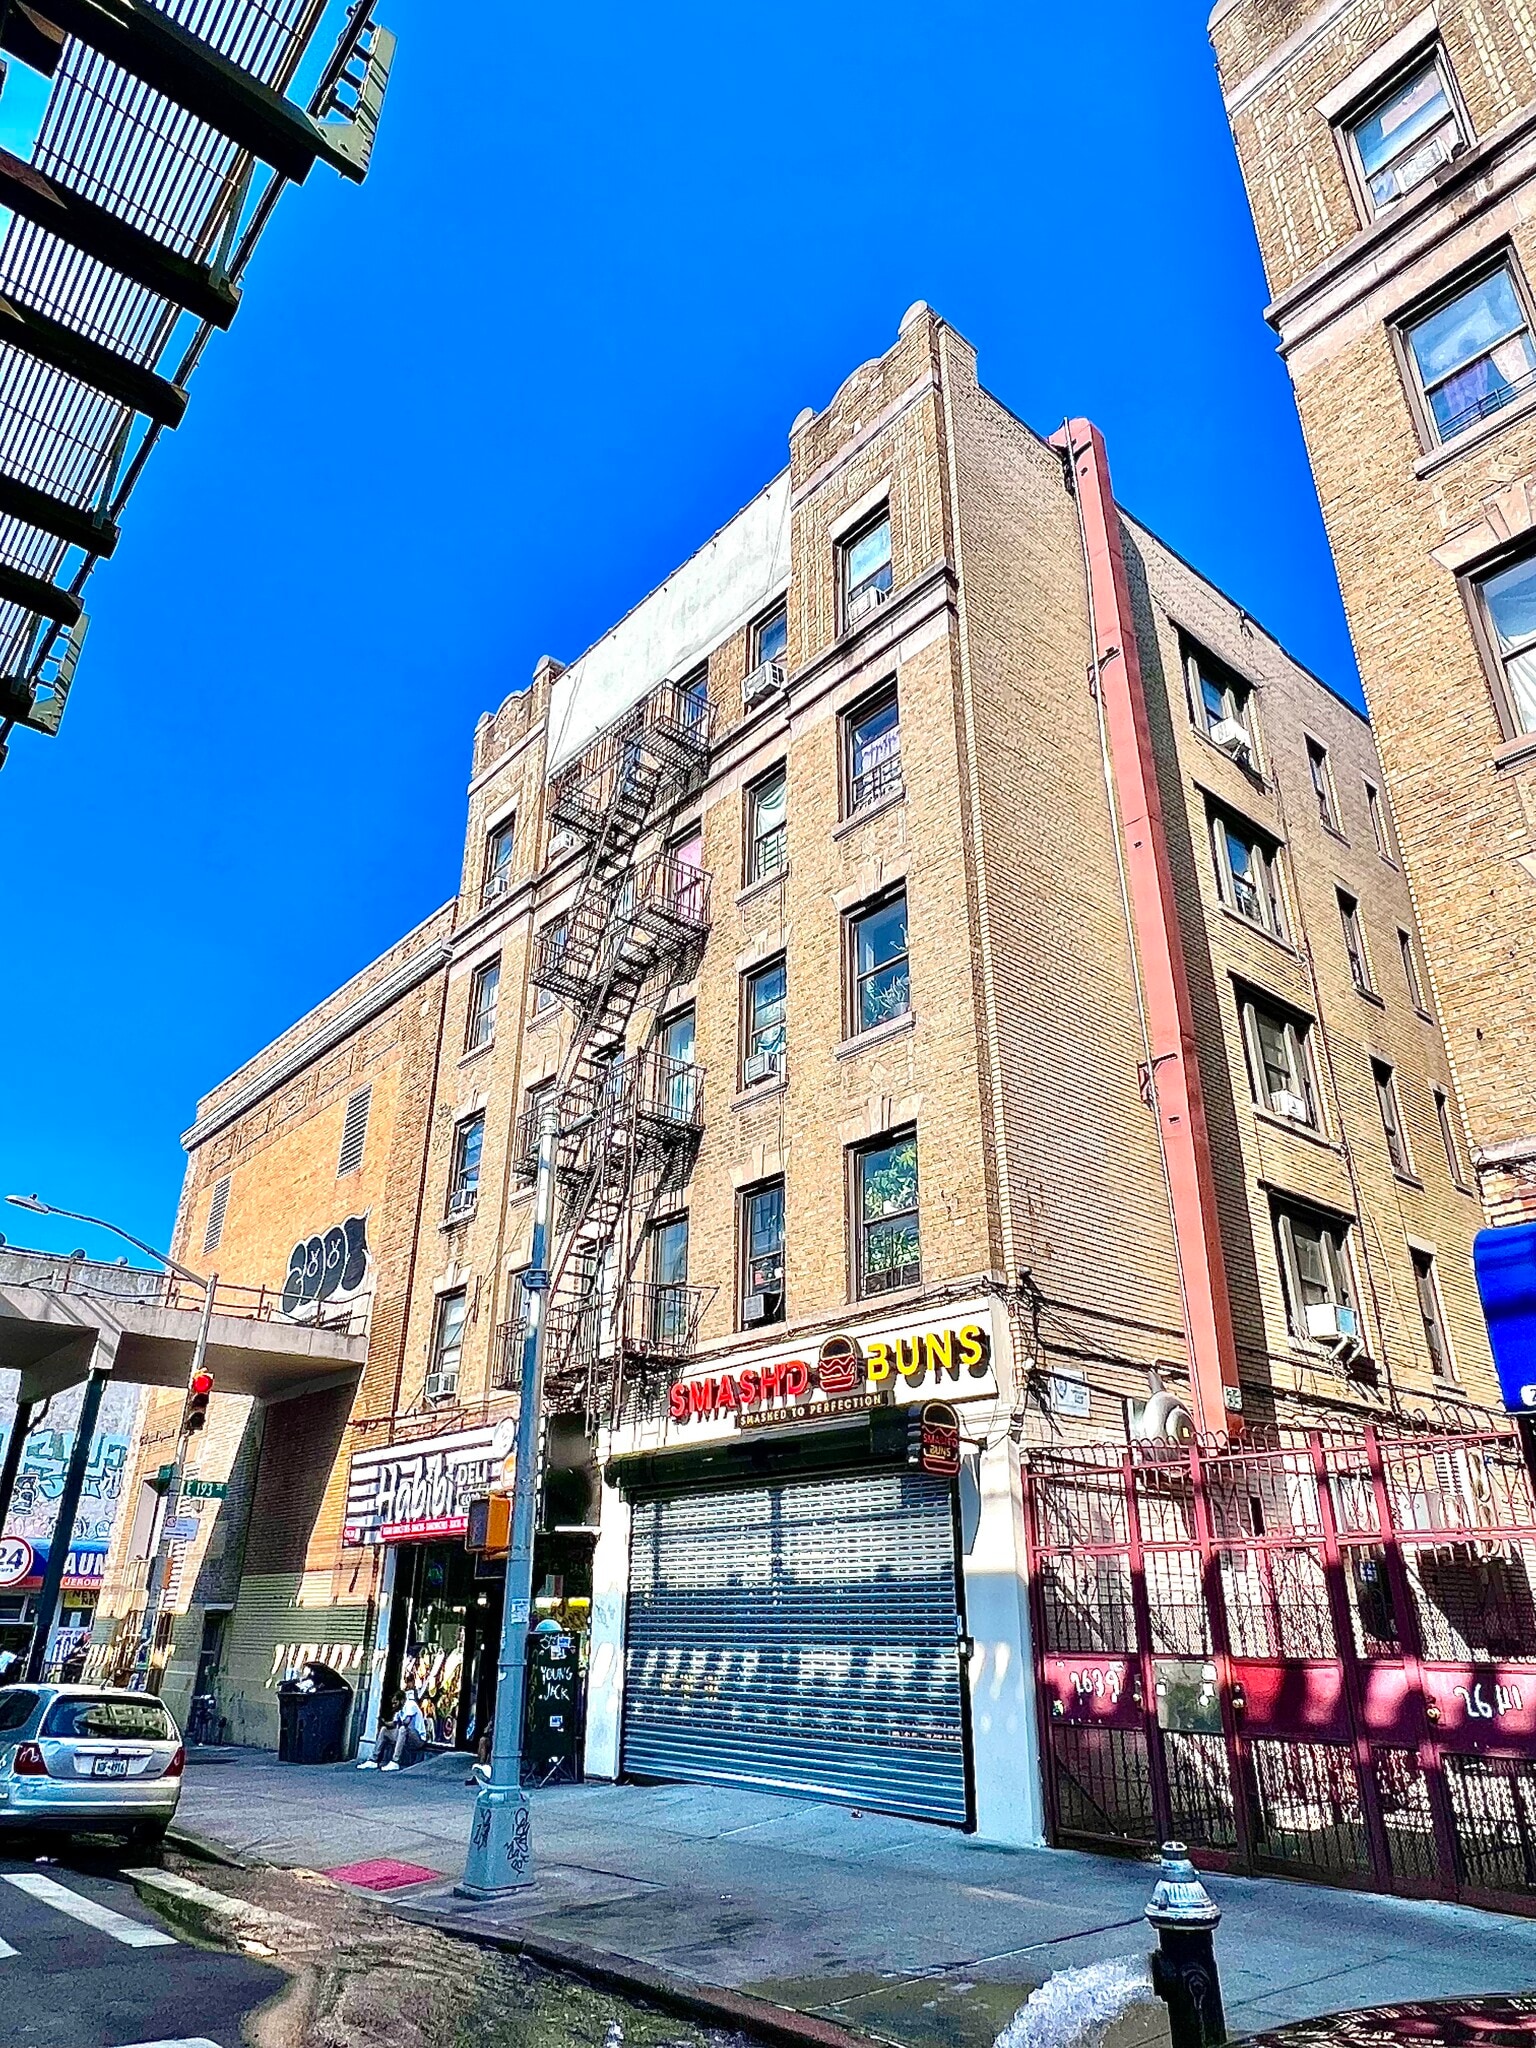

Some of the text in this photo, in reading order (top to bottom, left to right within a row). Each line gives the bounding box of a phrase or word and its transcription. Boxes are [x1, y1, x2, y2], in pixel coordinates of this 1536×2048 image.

[671, 1324, 983, 1417] SMASH'D BUNS
[739, 1394, 882, 1427] SMASHED TO PERFECTION
[186, 1481, 193, 1496] E
[196, 1482, 213, 1497] 193
[376, 1453, 488, 1523] Habibi DELI
[1069, 1668, 1121, 1699] 2639
